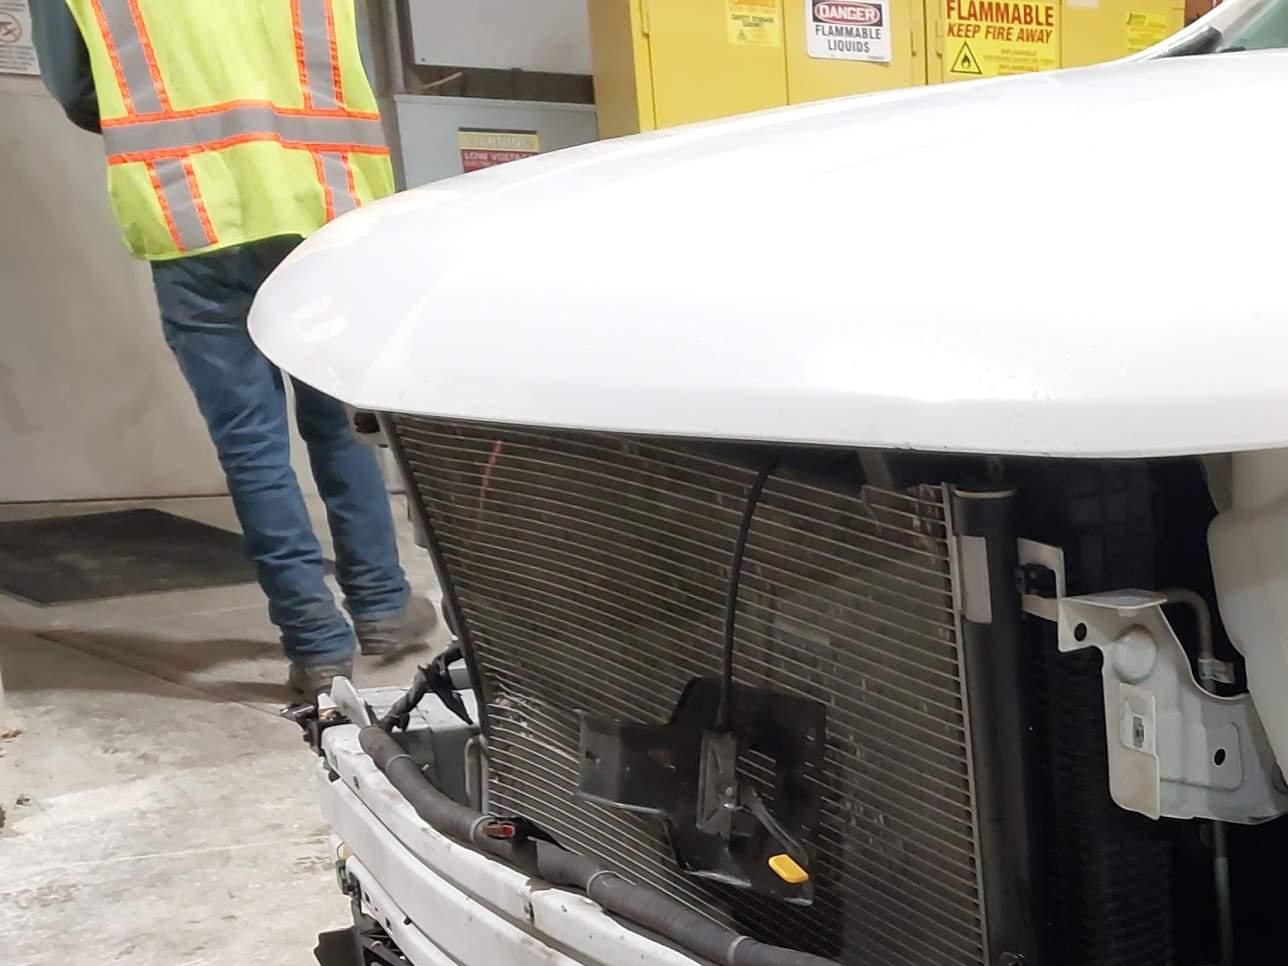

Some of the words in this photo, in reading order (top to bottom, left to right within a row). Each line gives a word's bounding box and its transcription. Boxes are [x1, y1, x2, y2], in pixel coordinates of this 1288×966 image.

[820, 5, 876, 21] DANGER
[946, 0, 1054, 27] FLAMMABLE
[815, 25, 882, 40] FLAMMABLE
[947, 23, 981, 39] KEEP
[985, 25, 1014, 42] FIRE
[1016, 28, 1053, 44] AWAY
[828, 40, 870, 53] LIQUIDS
[464, 152, 487, 161] LOW
